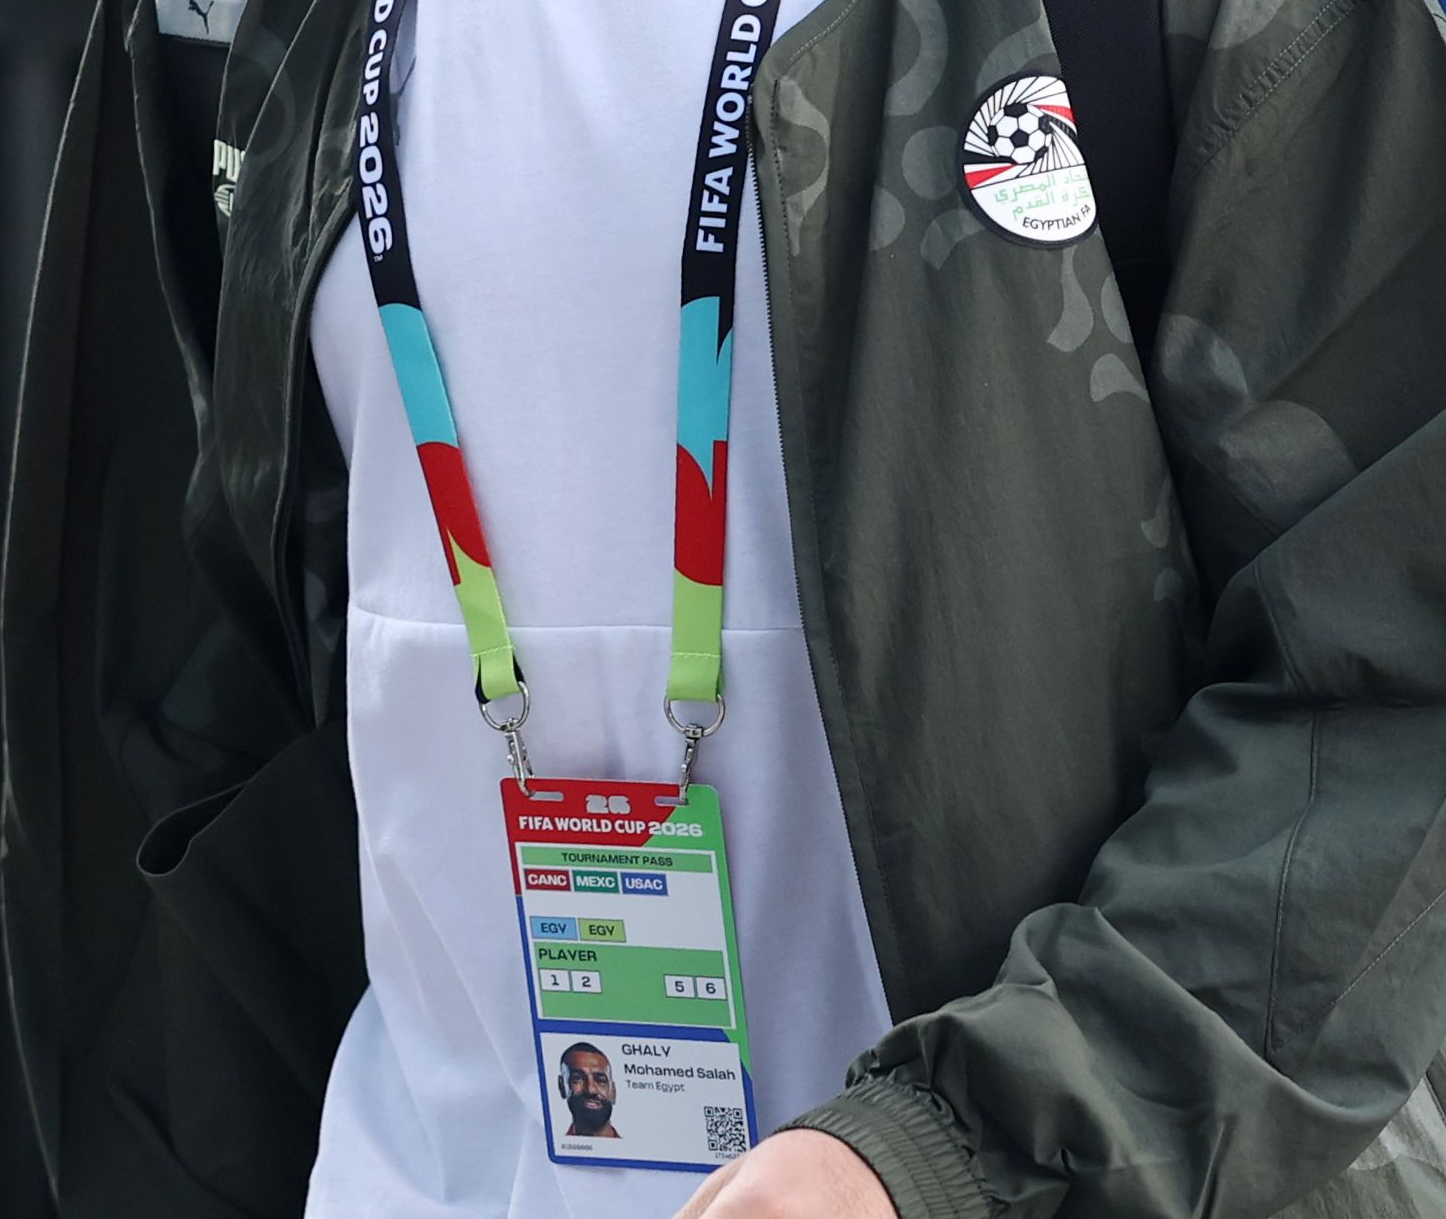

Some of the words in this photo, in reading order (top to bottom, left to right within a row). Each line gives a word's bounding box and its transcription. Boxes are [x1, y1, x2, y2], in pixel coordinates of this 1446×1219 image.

[363, 29, 387, 105] CUP
[708, 14, 761, 158] WORLD
[212, 139, 246, 183] PU
[696, 166, 733, 253] FIFA
[1022, 213, 1081, 230] EGYPTIAN
[518, 816, 555, 830] FIFA
[555, 817, 612, 832] WORLD
[614, 820, 646, 834] CUP
[648, 822, 703, 837] 2026
[561, 852, 640, 865] TOURNAMENT
[642, 855, 673, 867] PASS
[527, 873, 567, 886] CANC
[576, 875, 615, 888] MEXC
[625, 877, 663, 890] USAC
[540, 922, 566, 934] EGY
[589, 924, 615, 936] EGY
[538, 948, 597, 962] PLAYER
[550, 974, 560, 986] 1
[581, 976, 592, 988] 2
[674, 981, 685, 993] 5
[705, 983, 717, 995] 6
[621, 1044, 671, 1057] GHALY
[624, 1064, 694, 1078] Mohamed
[696, 1067, 736, 1080] Salah
[626, 1080, 654, 1090] Team
[656, 1081, 686, 1093] Egypt
